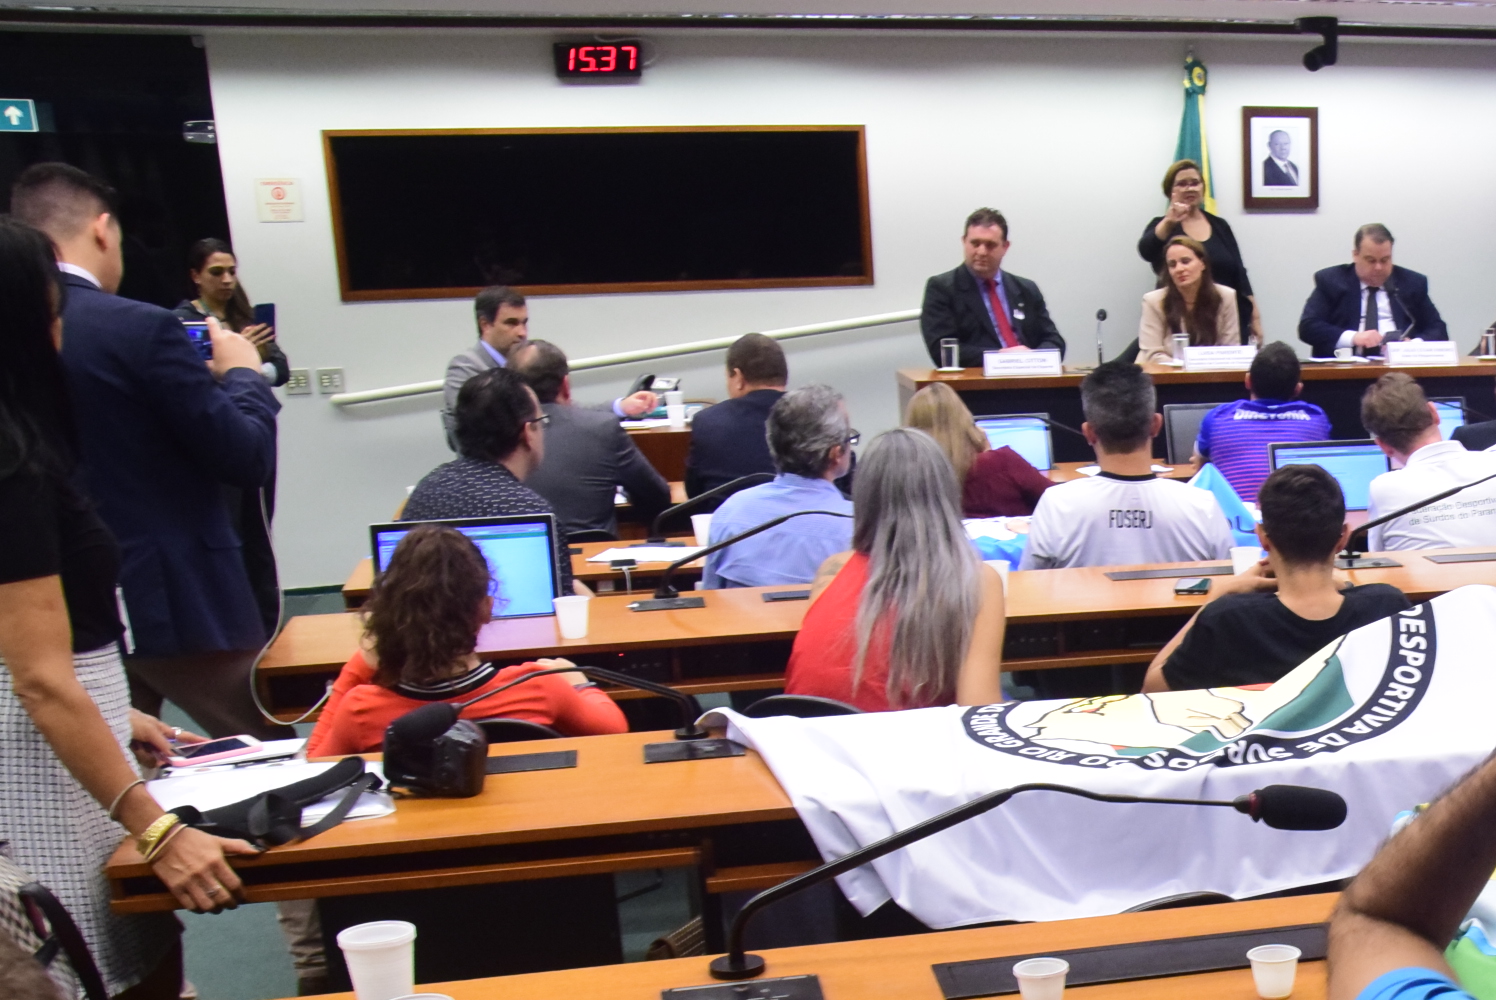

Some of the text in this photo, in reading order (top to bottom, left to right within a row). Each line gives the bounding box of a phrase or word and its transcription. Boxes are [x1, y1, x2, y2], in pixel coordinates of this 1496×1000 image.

[1408, 517, 1420, 526] de
[1423, 513, 1455, 524] Surdos
[1457, 511, 1468, 520] do
[969, 712, 1025, 748] GRANDE
[1296, 732, 1350, 753] DE
[1018, 746, 1078, 761] RIO
